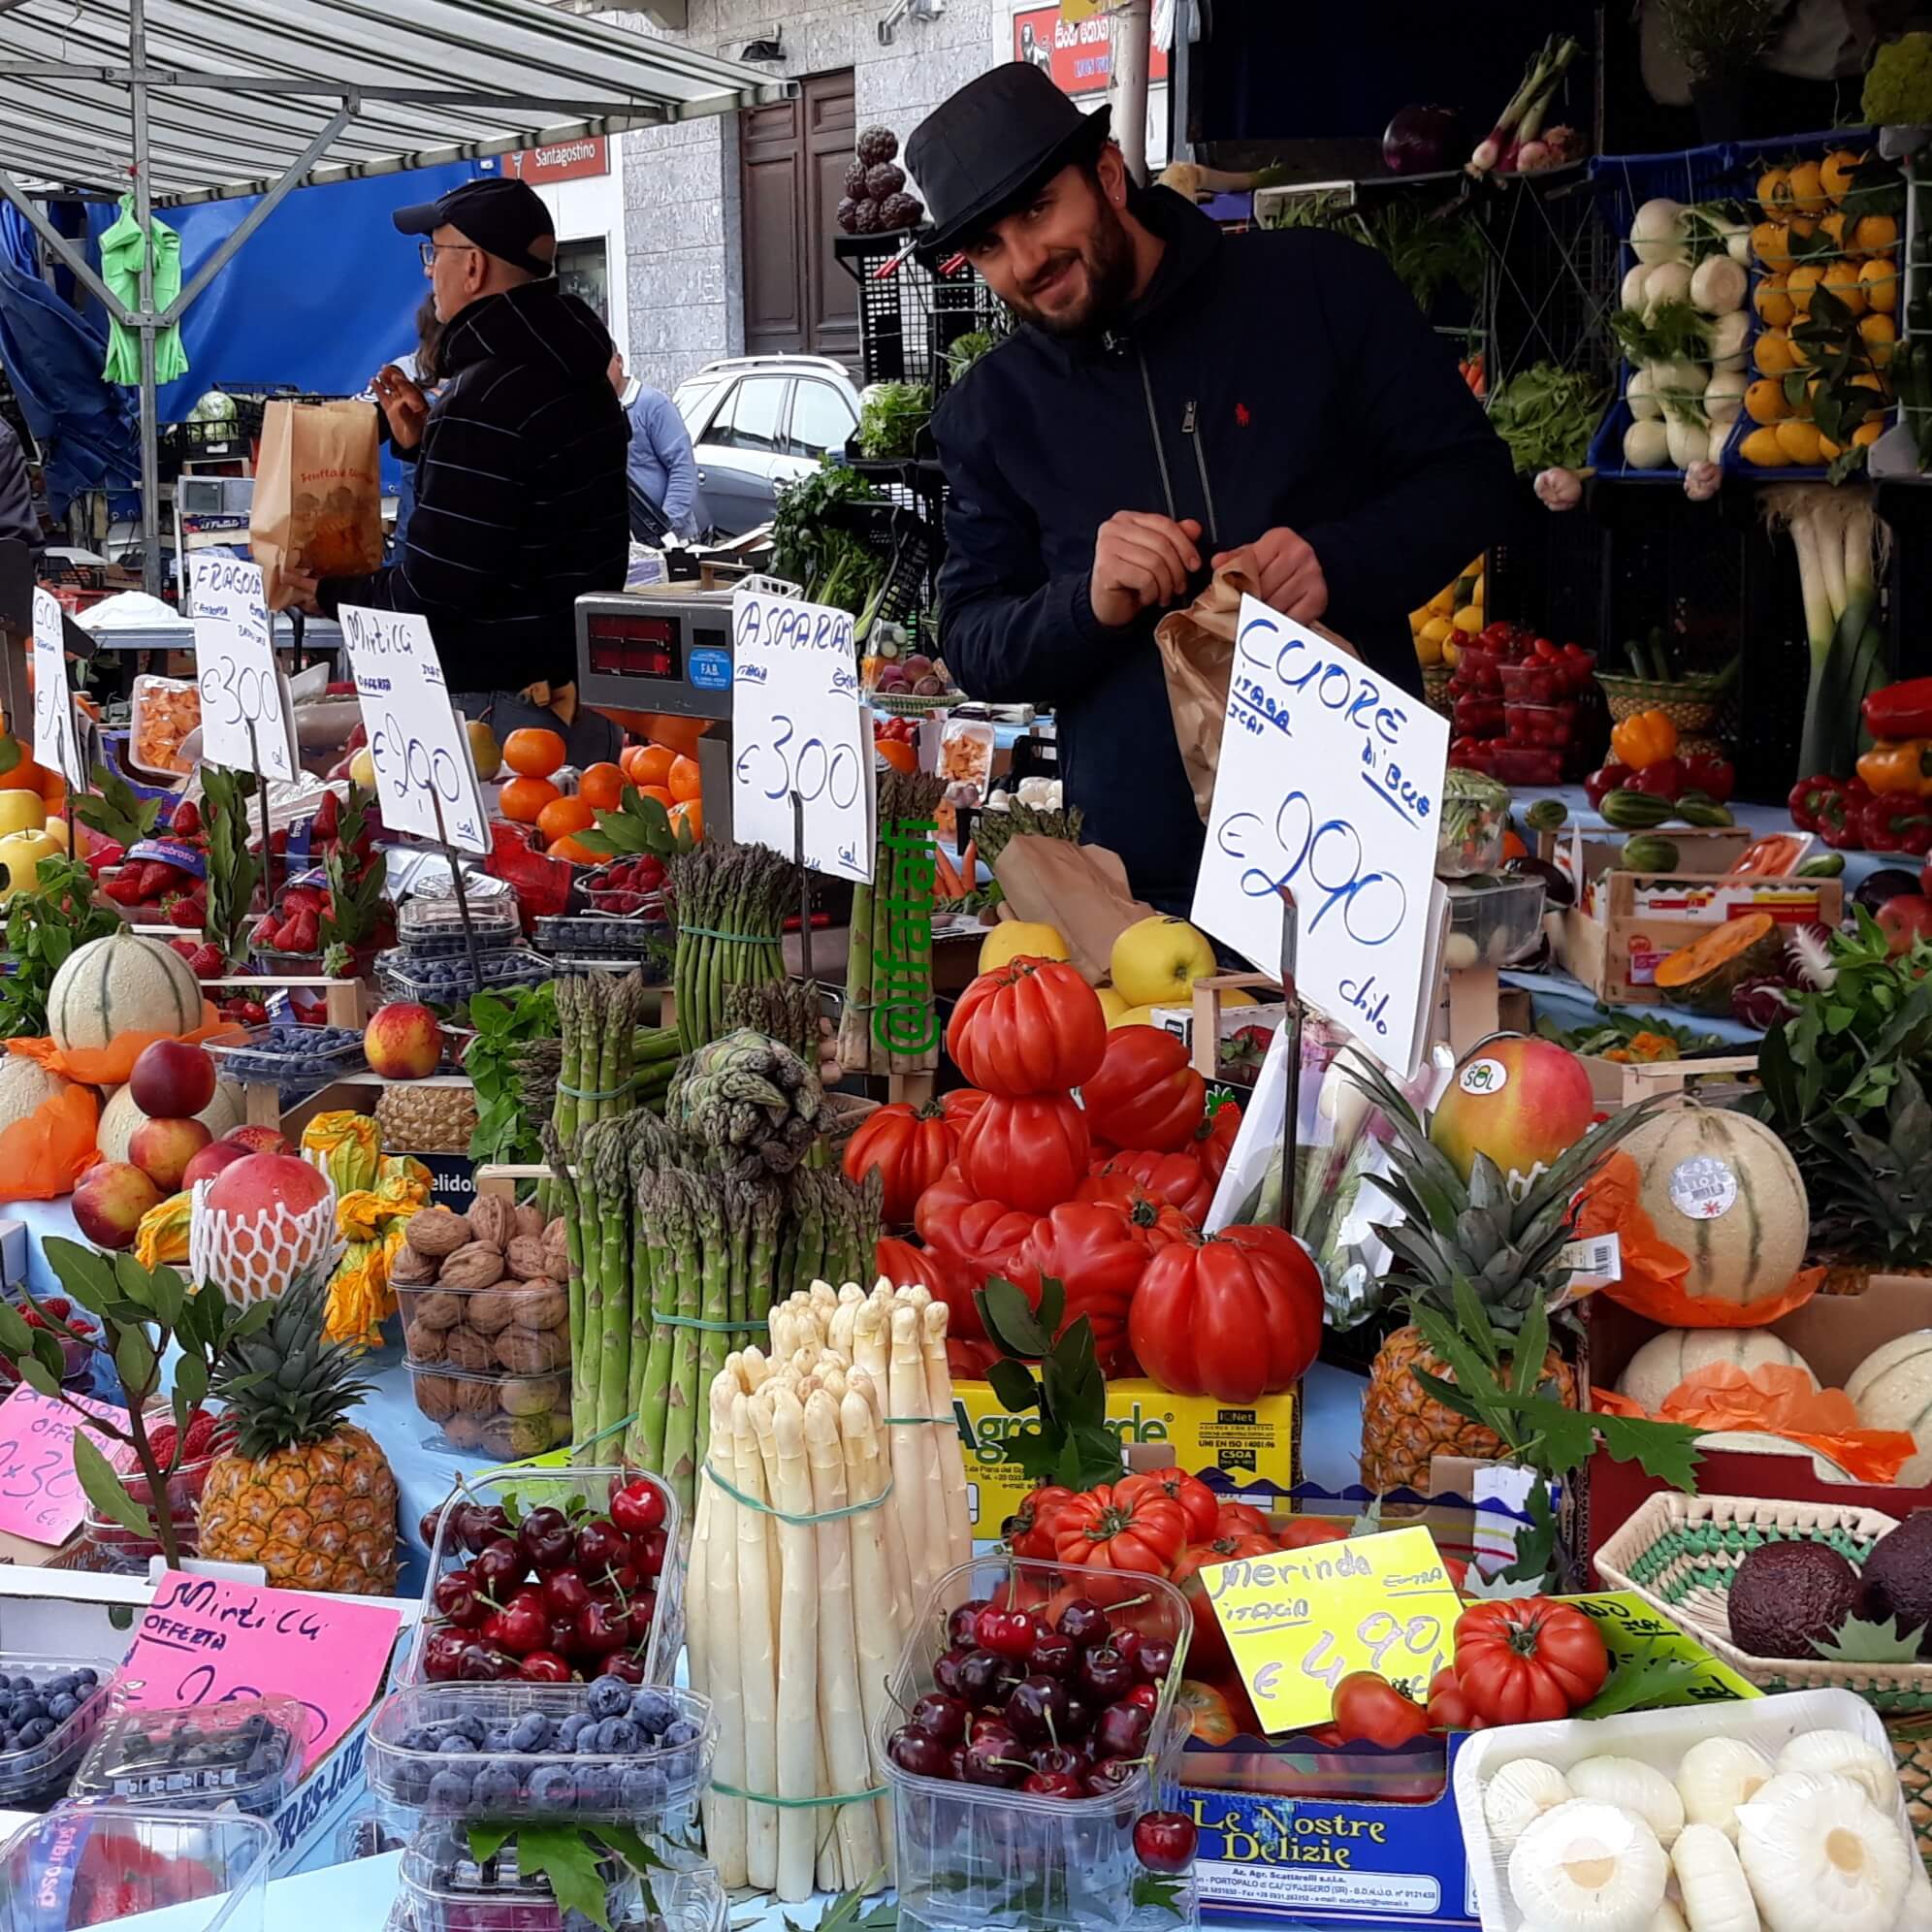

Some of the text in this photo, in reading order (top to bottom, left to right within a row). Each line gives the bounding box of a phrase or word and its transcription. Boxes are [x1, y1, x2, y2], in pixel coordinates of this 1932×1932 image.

[534, 141, 596, 168] Santagostino
[1240, 618, 1407, 745] CUORE
[1338, 975, 1390, 1035] chilo
[1464, 1070, 1494, 1091] SOL
[1211, 1544, 1372, 1600] Merinda
[144, 1614, 228, 1652] OFFERTA
[1189, 1798, 1386, 1844] Le Nostre
[1221, 1831, 1352, 1870] Delizie
[1210, 1876, 1259, 1888] PORTOPALO
